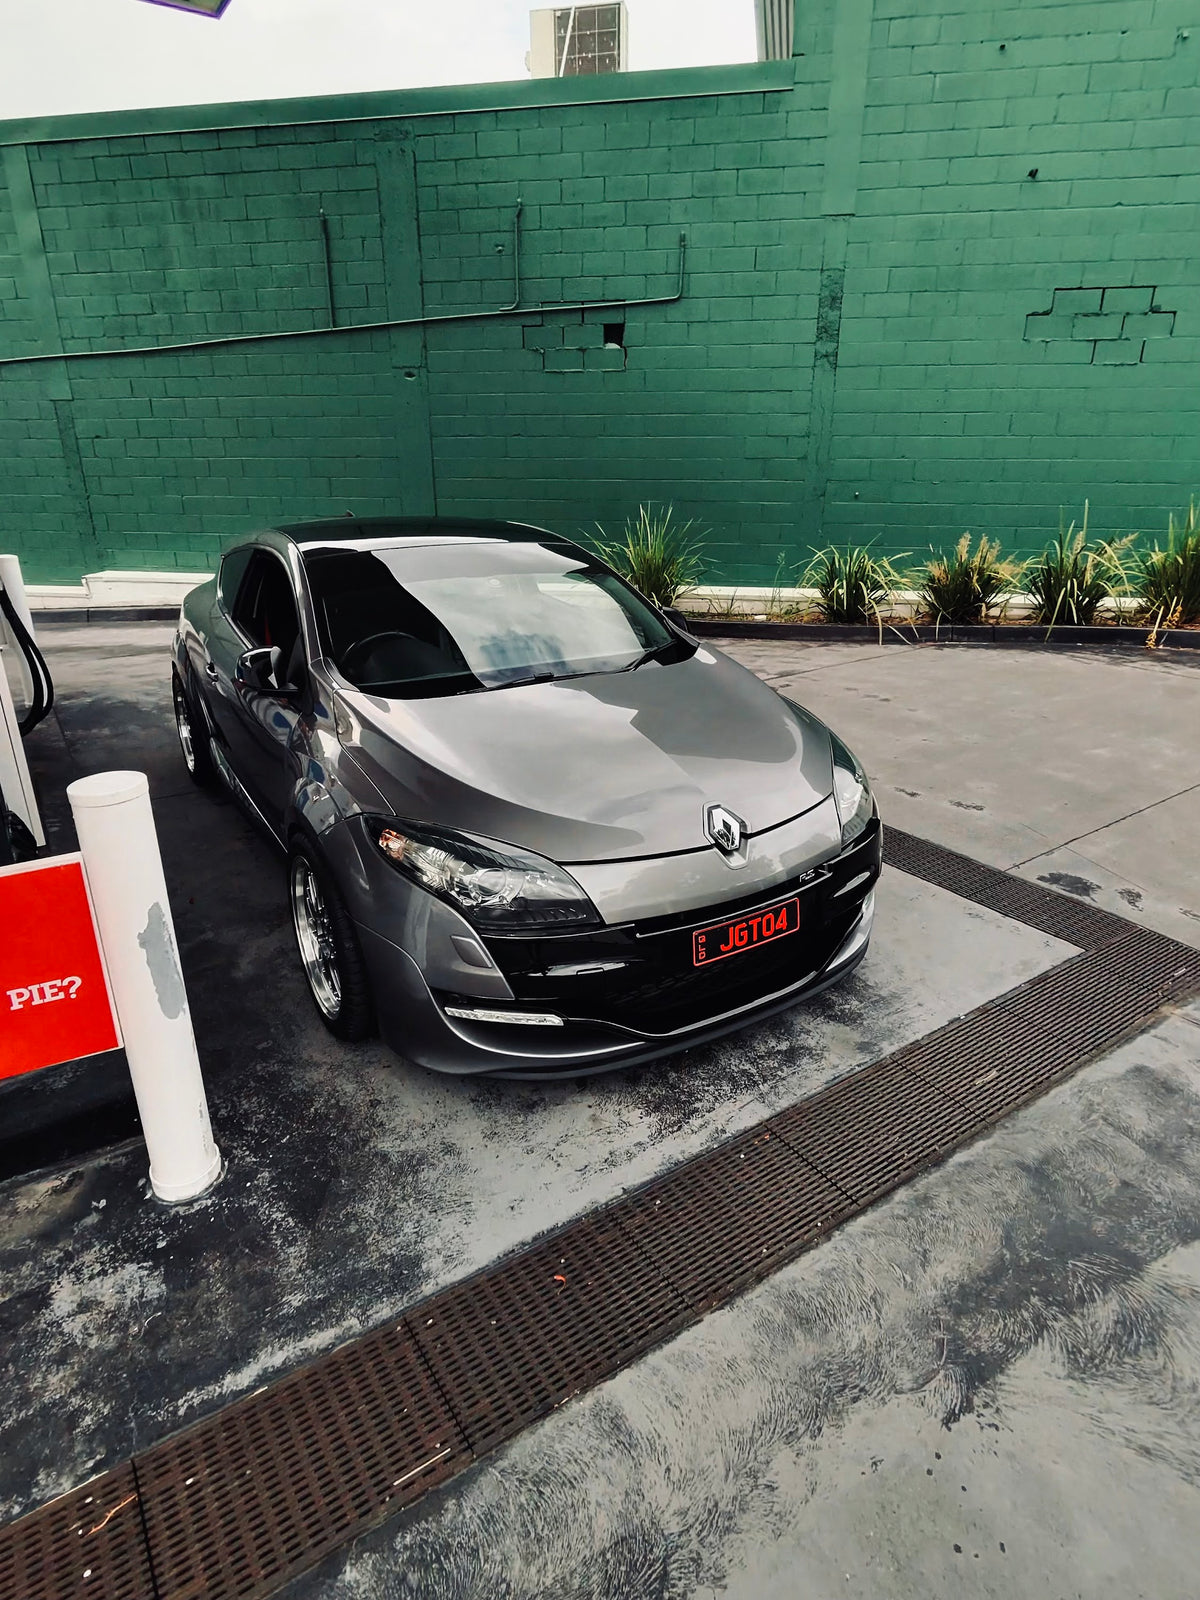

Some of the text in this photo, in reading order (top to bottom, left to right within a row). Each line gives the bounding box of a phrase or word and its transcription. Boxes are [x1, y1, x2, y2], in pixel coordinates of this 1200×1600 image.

[698, 934, 706, 960] QLD
[720, 907, 788, 952] JGT04
[6, 976, 82, 1011] PIE?
